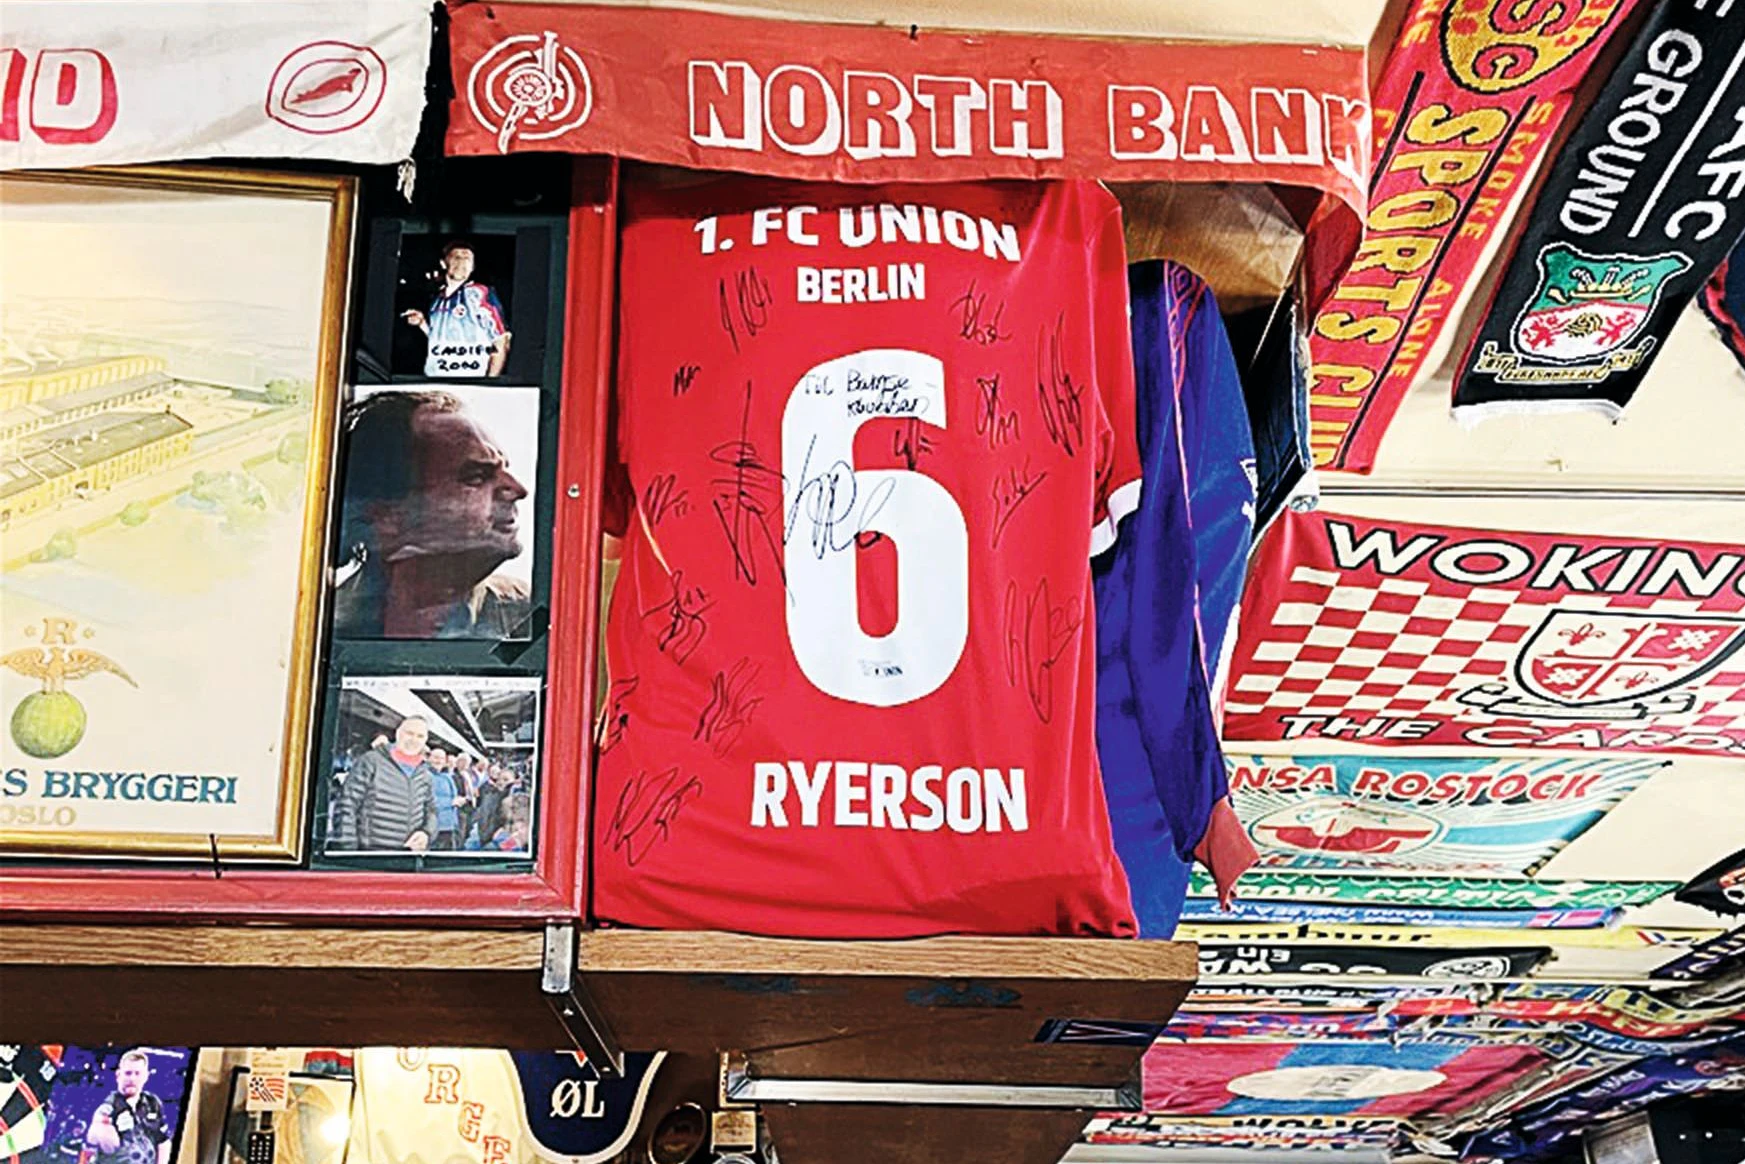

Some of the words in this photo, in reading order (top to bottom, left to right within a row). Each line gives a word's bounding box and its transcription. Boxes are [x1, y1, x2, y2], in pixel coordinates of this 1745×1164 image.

[688, 60, 1065, 161] NORTH
[1107, 84, 1368, 186] BANK
[1559, 28, 1703, 235] GROUND
[1459, 100, 1555, 241] SMOKE
[694, 217, 735, 254] 1.
[751, 206, 820, 246] FC
[838, 203, 1021, 262] UNION
[1315, 102, 1512, 345] SPORTS
[797, 262, 926, 304] BERLIN
[1389, 277, 1454, 378] ALONE
[437, 358, 480, 372] 2000
[781, 349, 968, 708] 6
[41, 617, 79, 645] R
[1281, 714, 1441, 741] THE
[0, 769, 28, 797] S
[41, 770, 239, 804] BRYGGERI
[750, 760, 1029, 834] RYERSON
[1354, 768, 1604, 801] ROSTOCK
[550, 1079, 605, 1118] ØL
